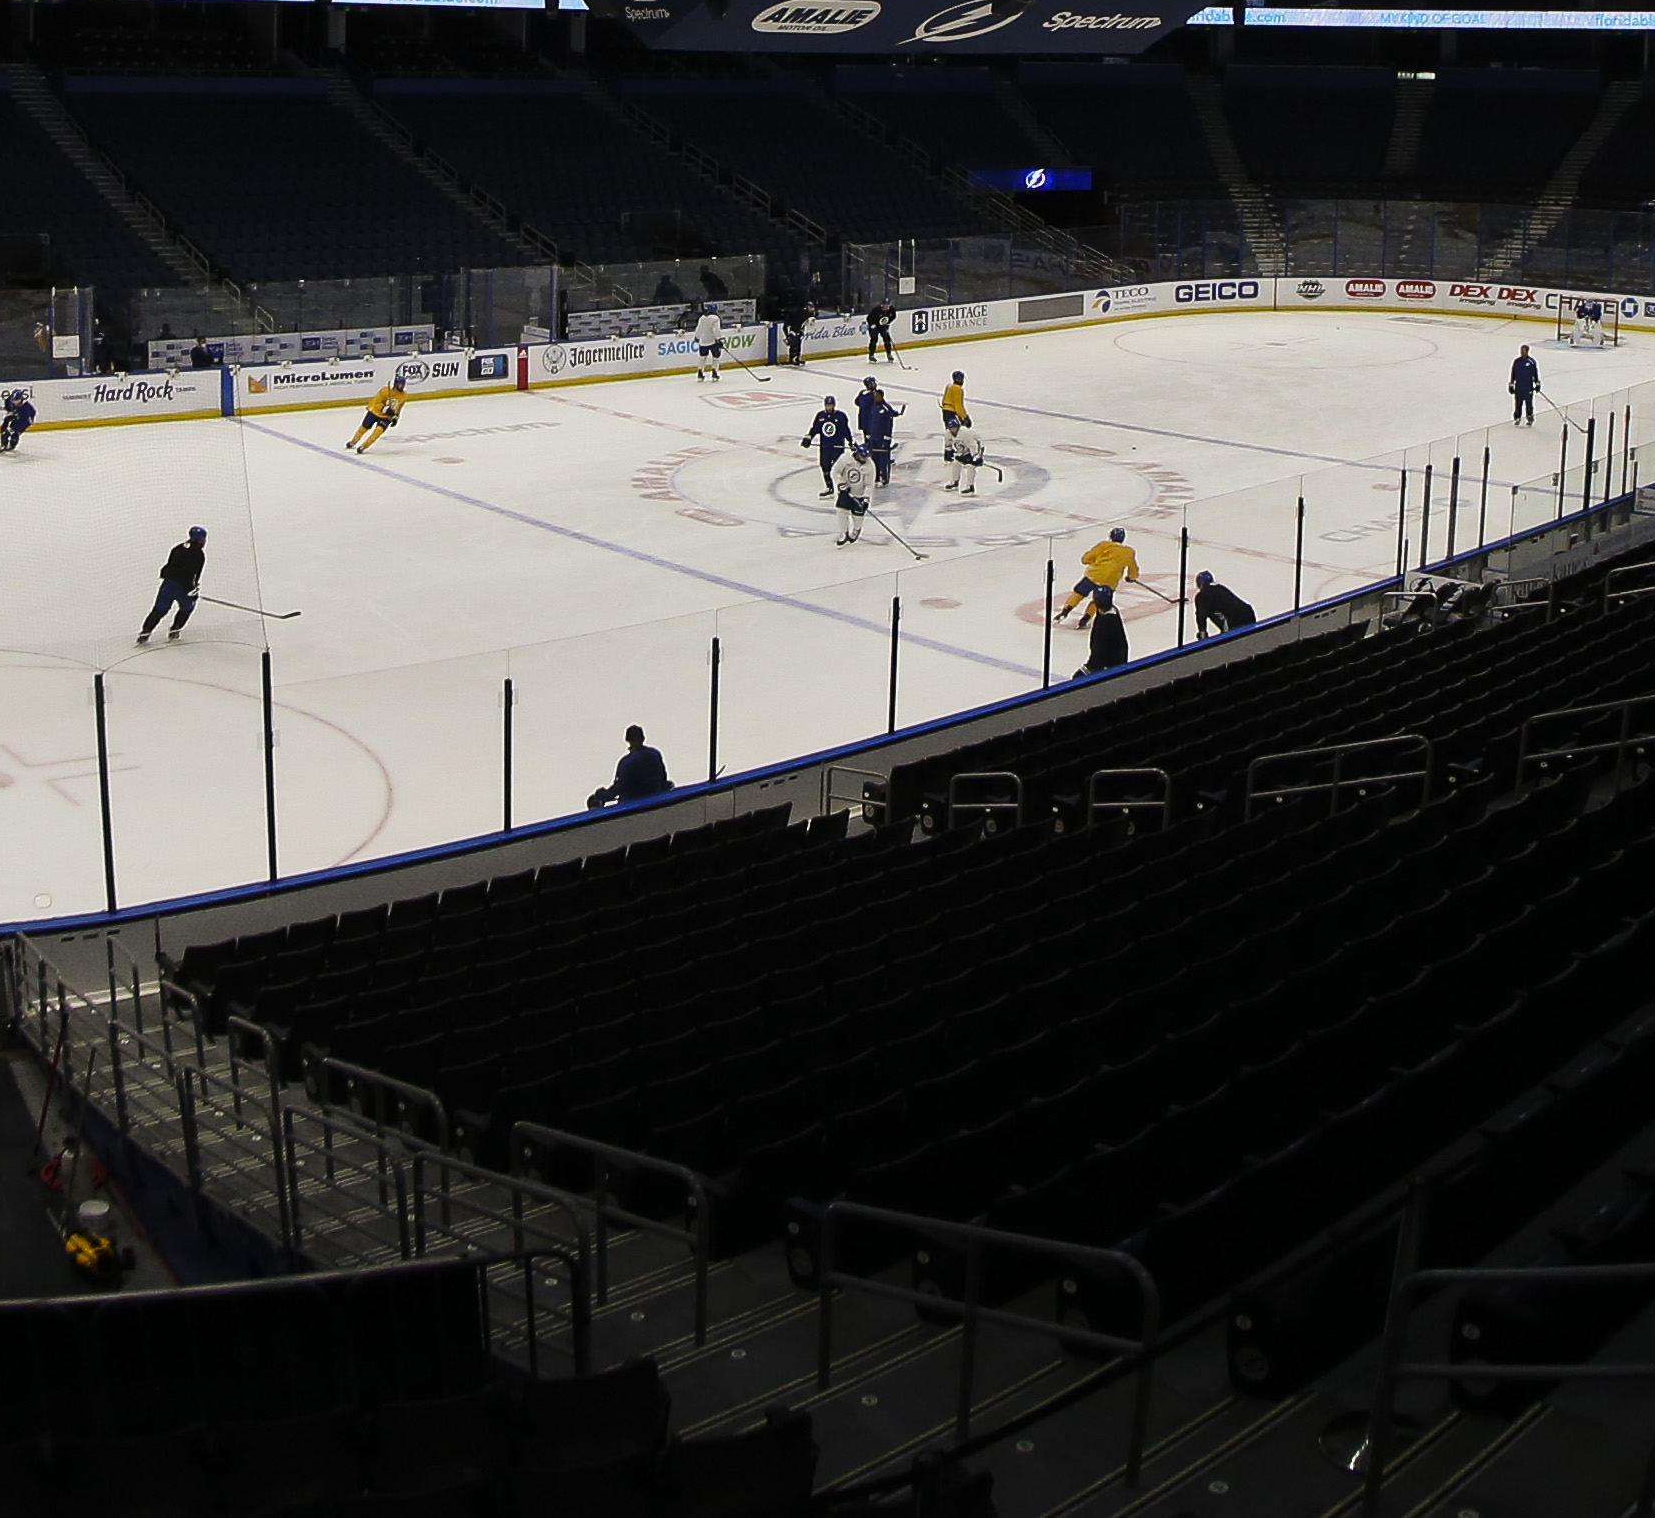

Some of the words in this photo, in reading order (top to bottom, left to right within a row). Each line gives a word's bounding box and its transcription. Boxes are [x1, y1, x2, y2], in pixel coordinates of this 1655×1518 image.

[624, 6, 667, 23] Spectrum
[762, 7, 875, 25] AMALIE
[1043, 10, 1156, 30] Spectrum
[1451, 13, 1488, 25] GOAL
[1113, 287, 1149, 299] TECO
[1175, 281, 1259, 303] GEICO
[1296, 284, 1325, 295] NHL
[1348, 283, 1384, 293] AMALIE
[1398, 284, 1434, 295] AMALIE
[1449, 284, 1492, 299] DEX
[1497, 287, 1538, 302] DEX
[931, 305, 988, 323] HERITAGE
[832, 324, 856, 338] Blue
[931, 318, 988, 333] INSURANCE
[273, 370, 374, 385] MicroLumen
[403, 364, 423, 378] FOX
[432, 362, 459, 378] SUN
[94, 383, 135, 403] Hard
[135, 381, 175, 403] Rock
